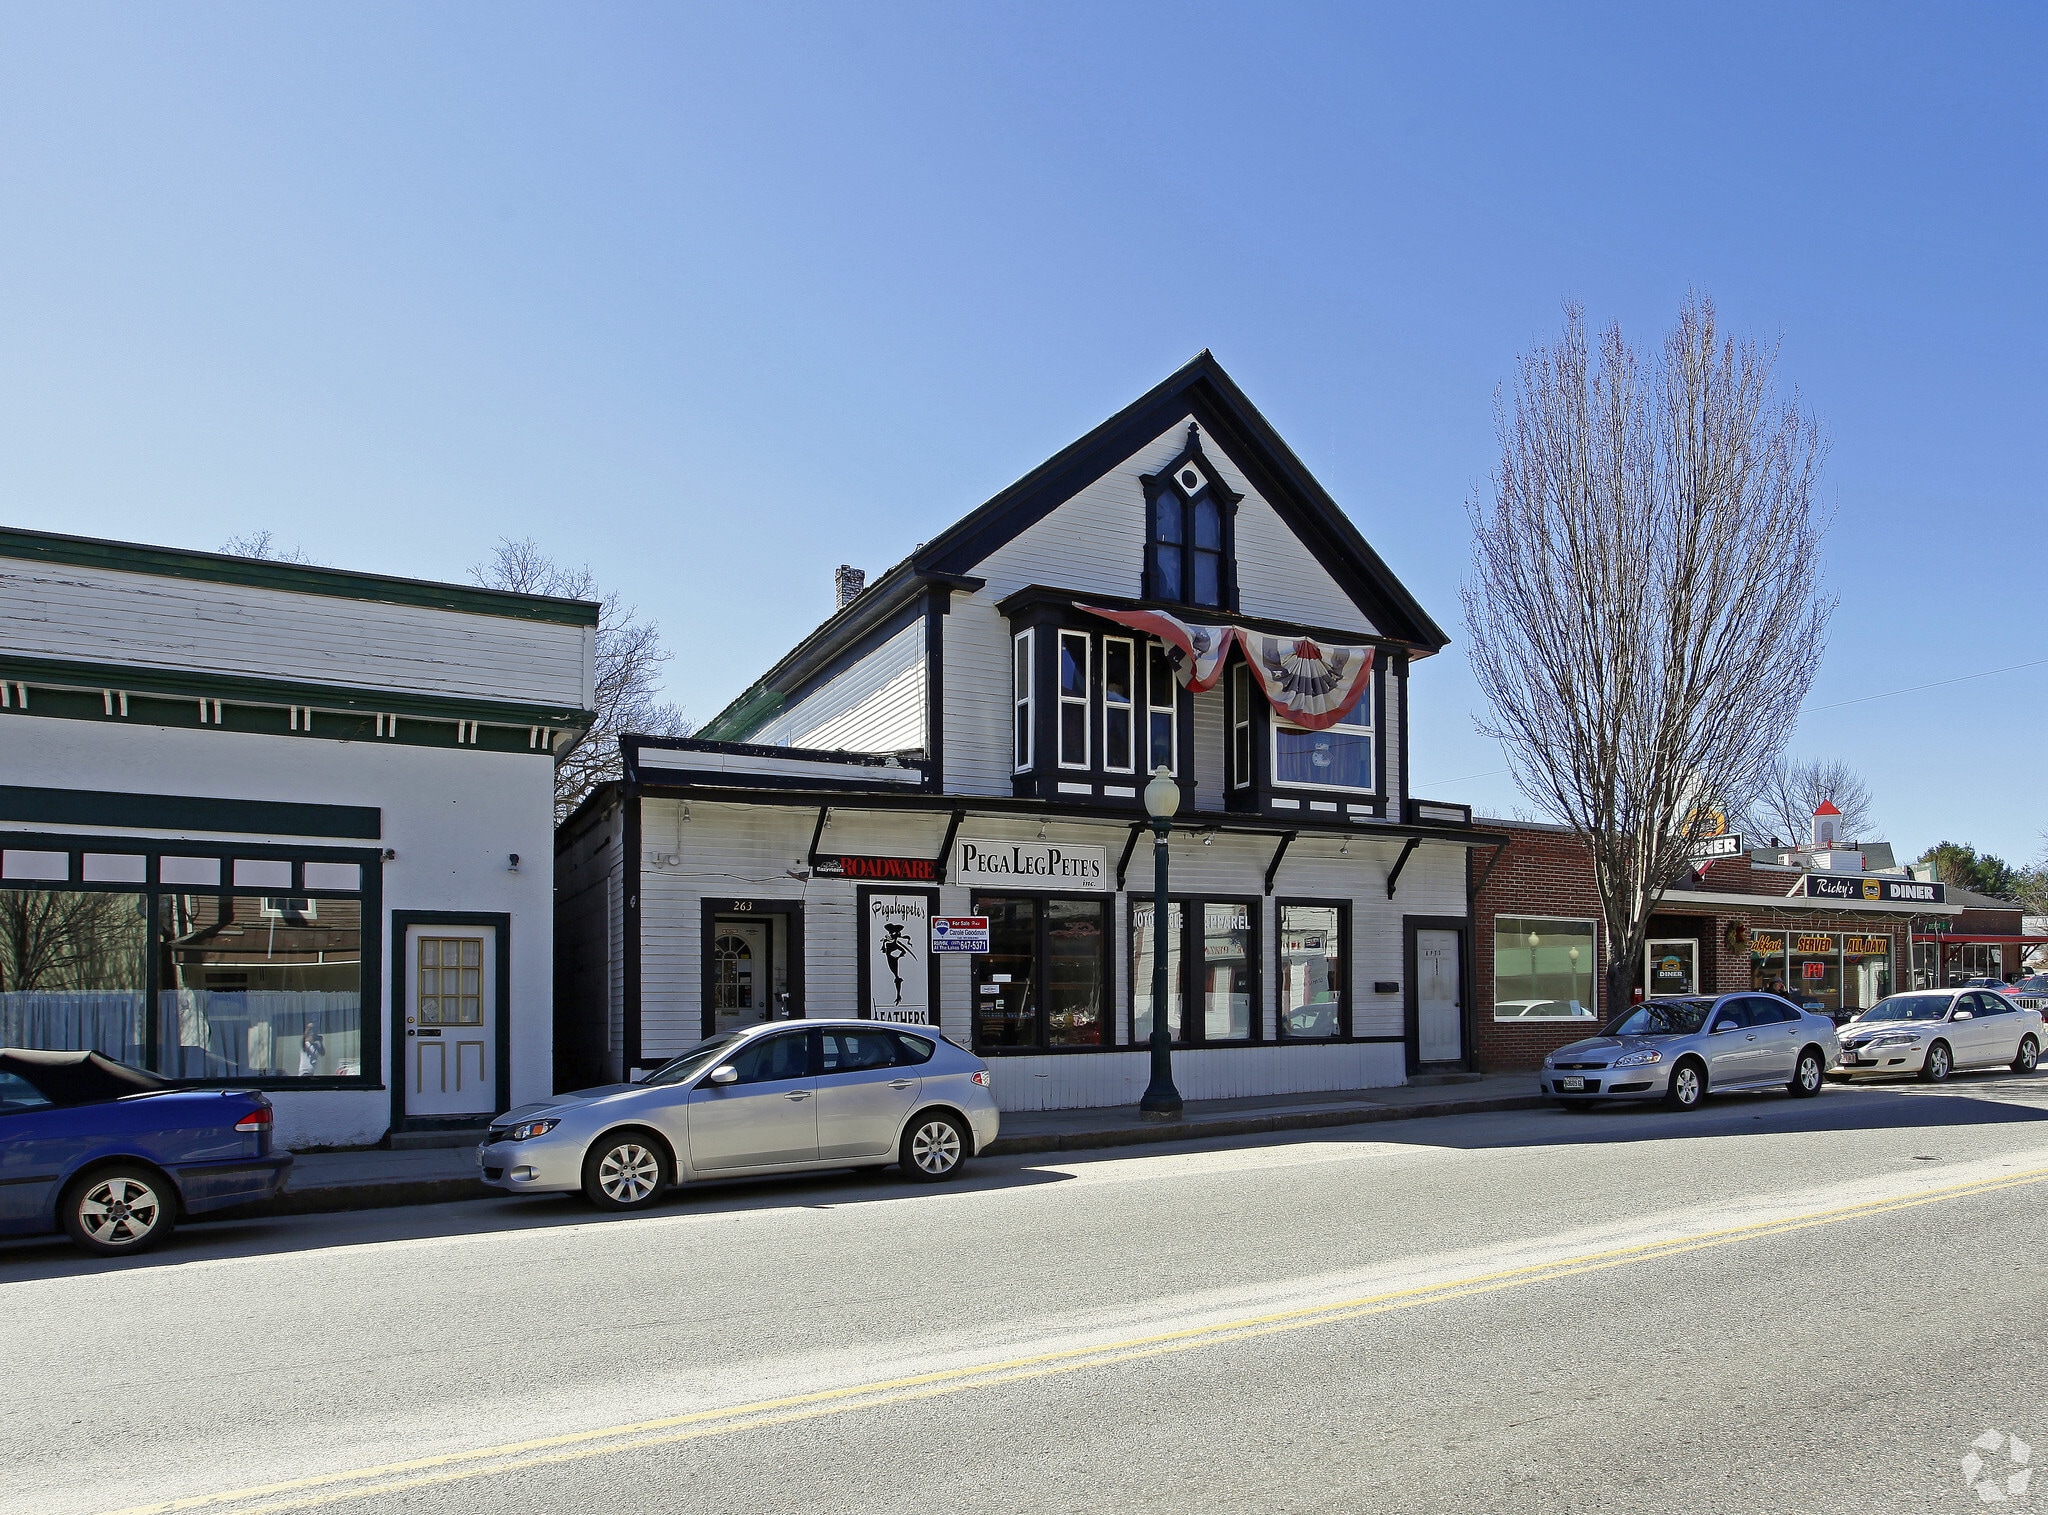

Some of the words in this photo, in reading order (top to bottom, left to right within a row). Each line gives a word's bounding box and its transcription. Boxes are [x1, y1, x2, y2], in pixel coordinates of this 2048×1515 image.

[840, 857, 936, 879] ROADWARE
[1816, 879, 1854, 898] Ricky's
[1890, 884, 1935, 900] DINER
[733, 901, 753, 911] 263
[960, 940, 986, 950] 647-5371
[1798, 937, 1831, 953] SERVED
[1846, 938, 1863, 953] ALL
[1803, 963, 1823, 978] OPEN
